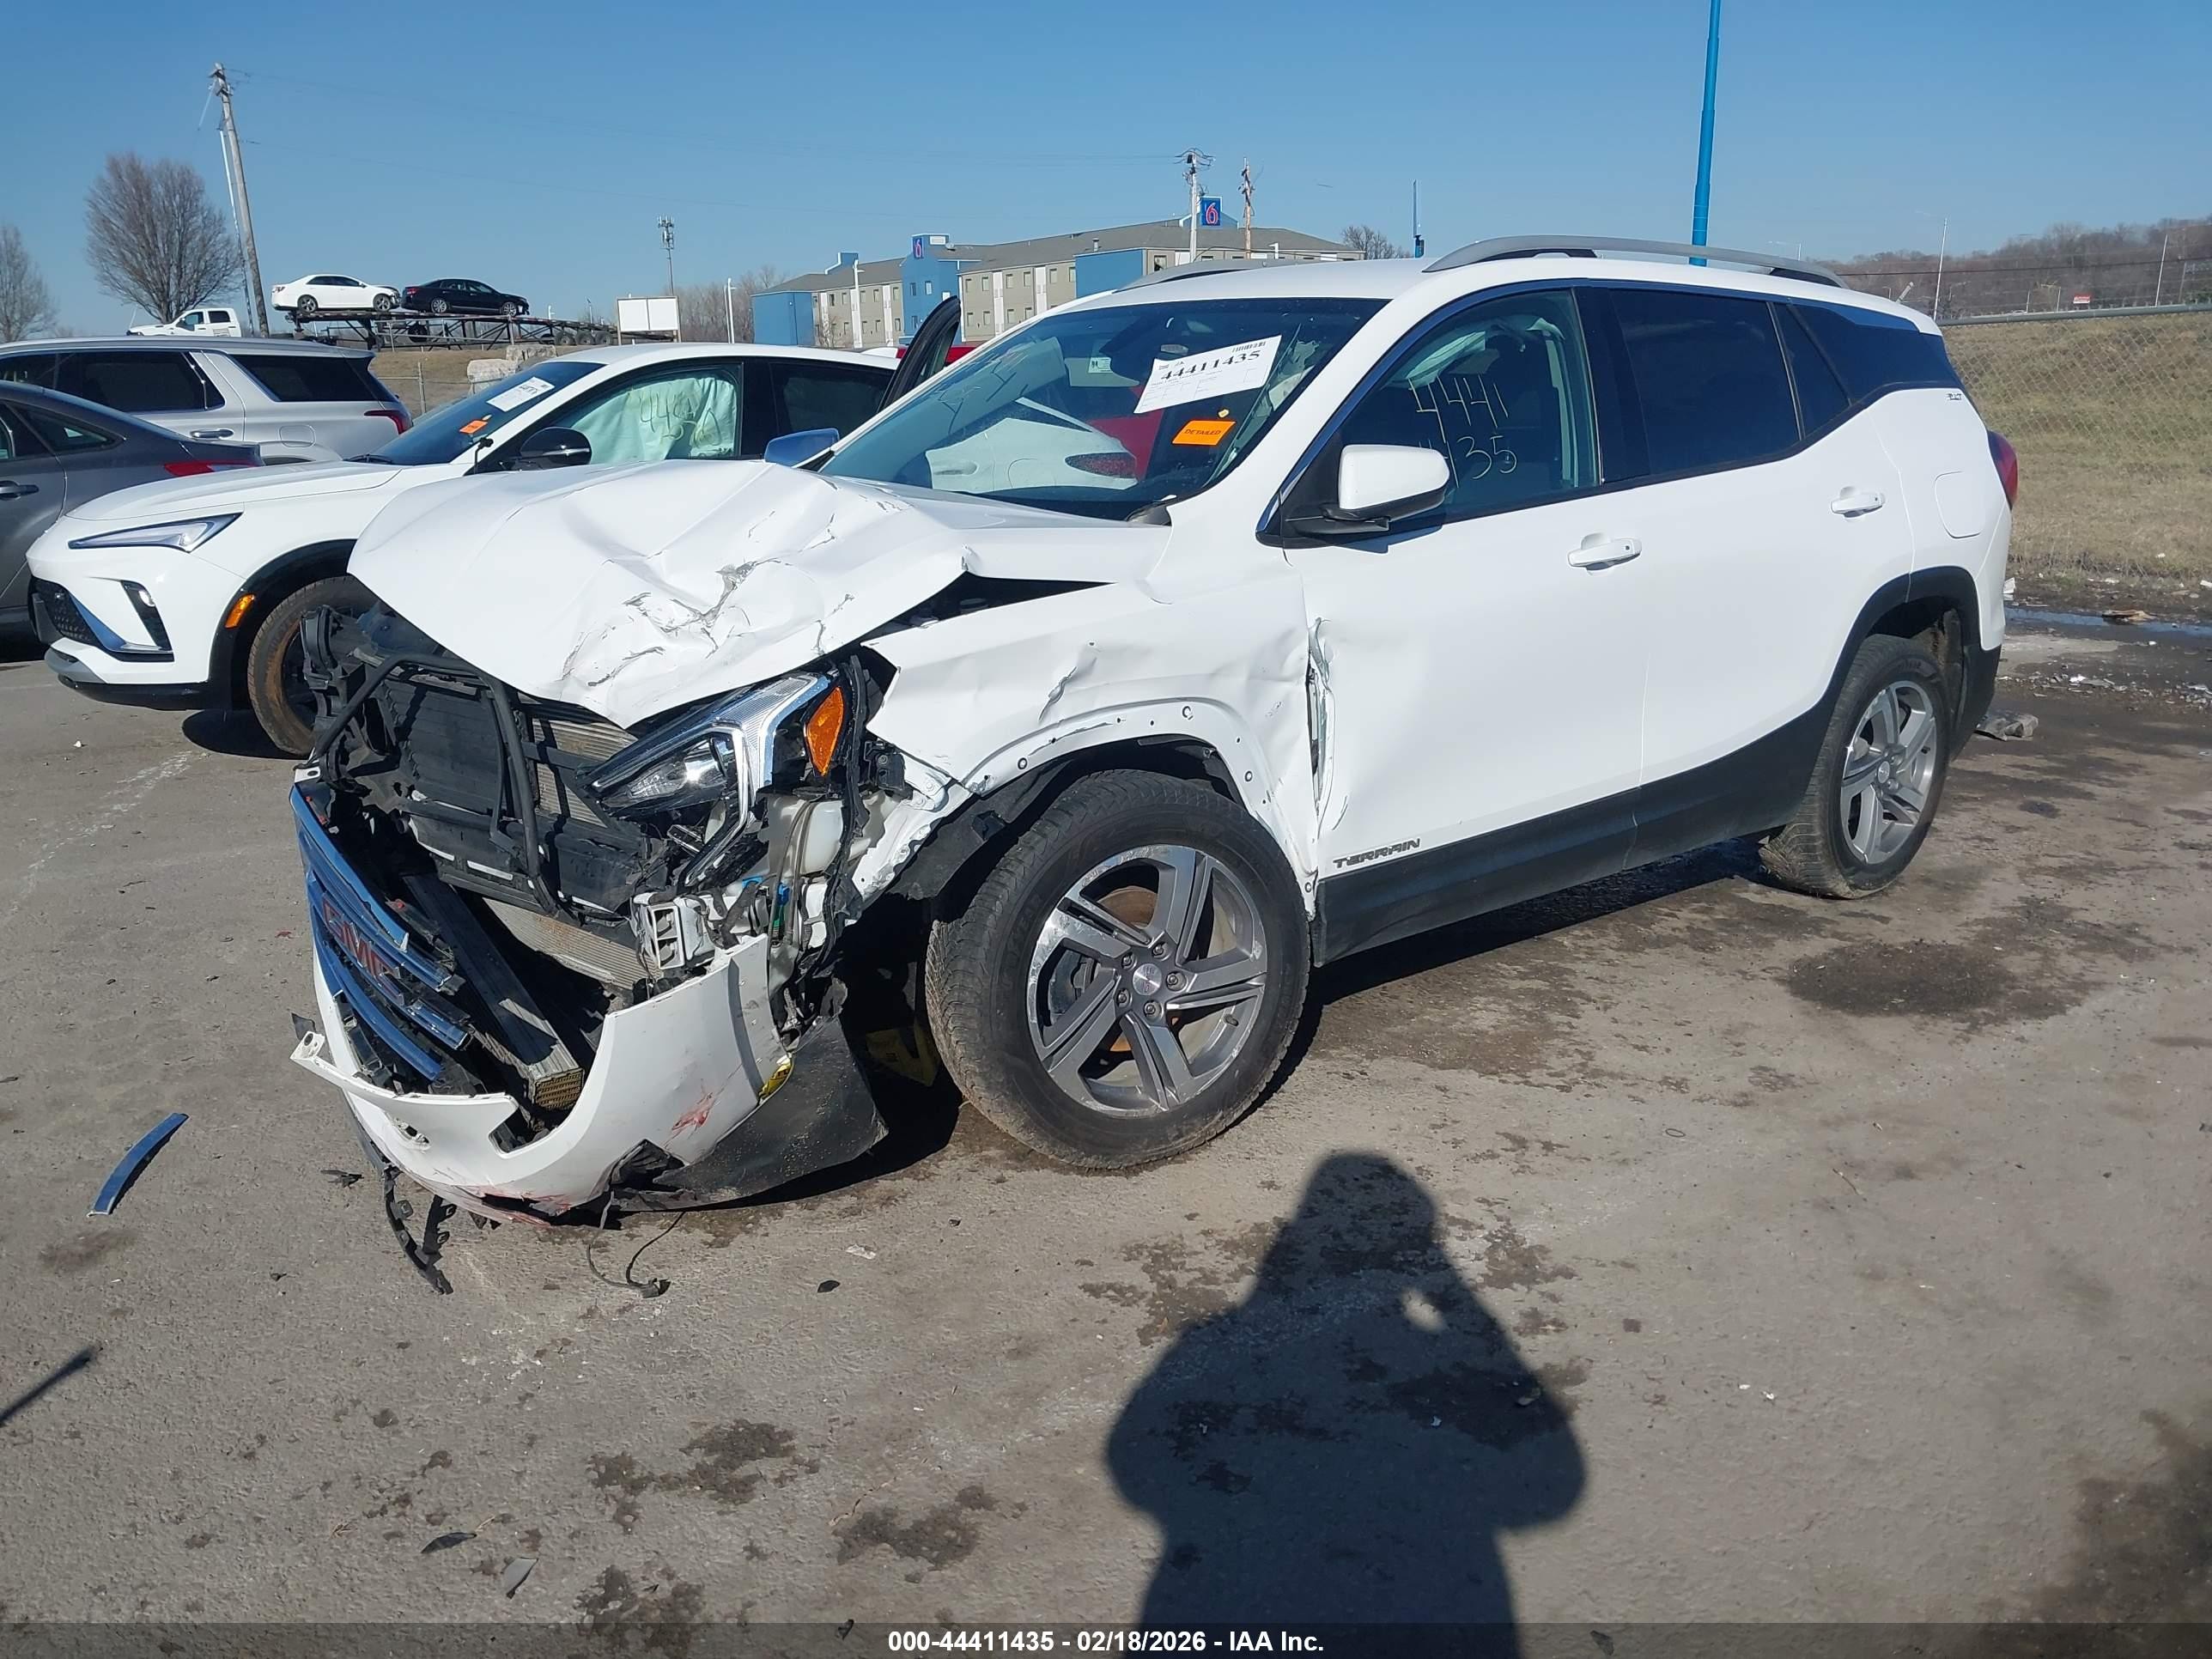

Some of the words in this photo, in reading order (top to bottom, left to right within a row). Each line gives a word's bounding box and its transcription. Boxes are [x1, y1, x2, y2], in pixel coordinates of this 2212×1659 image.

[1206, 202, 1218, 225] 6
[1160, 350, 1261, 380] 44411435
[1332, 838, 1421, 868] TERRAIN
